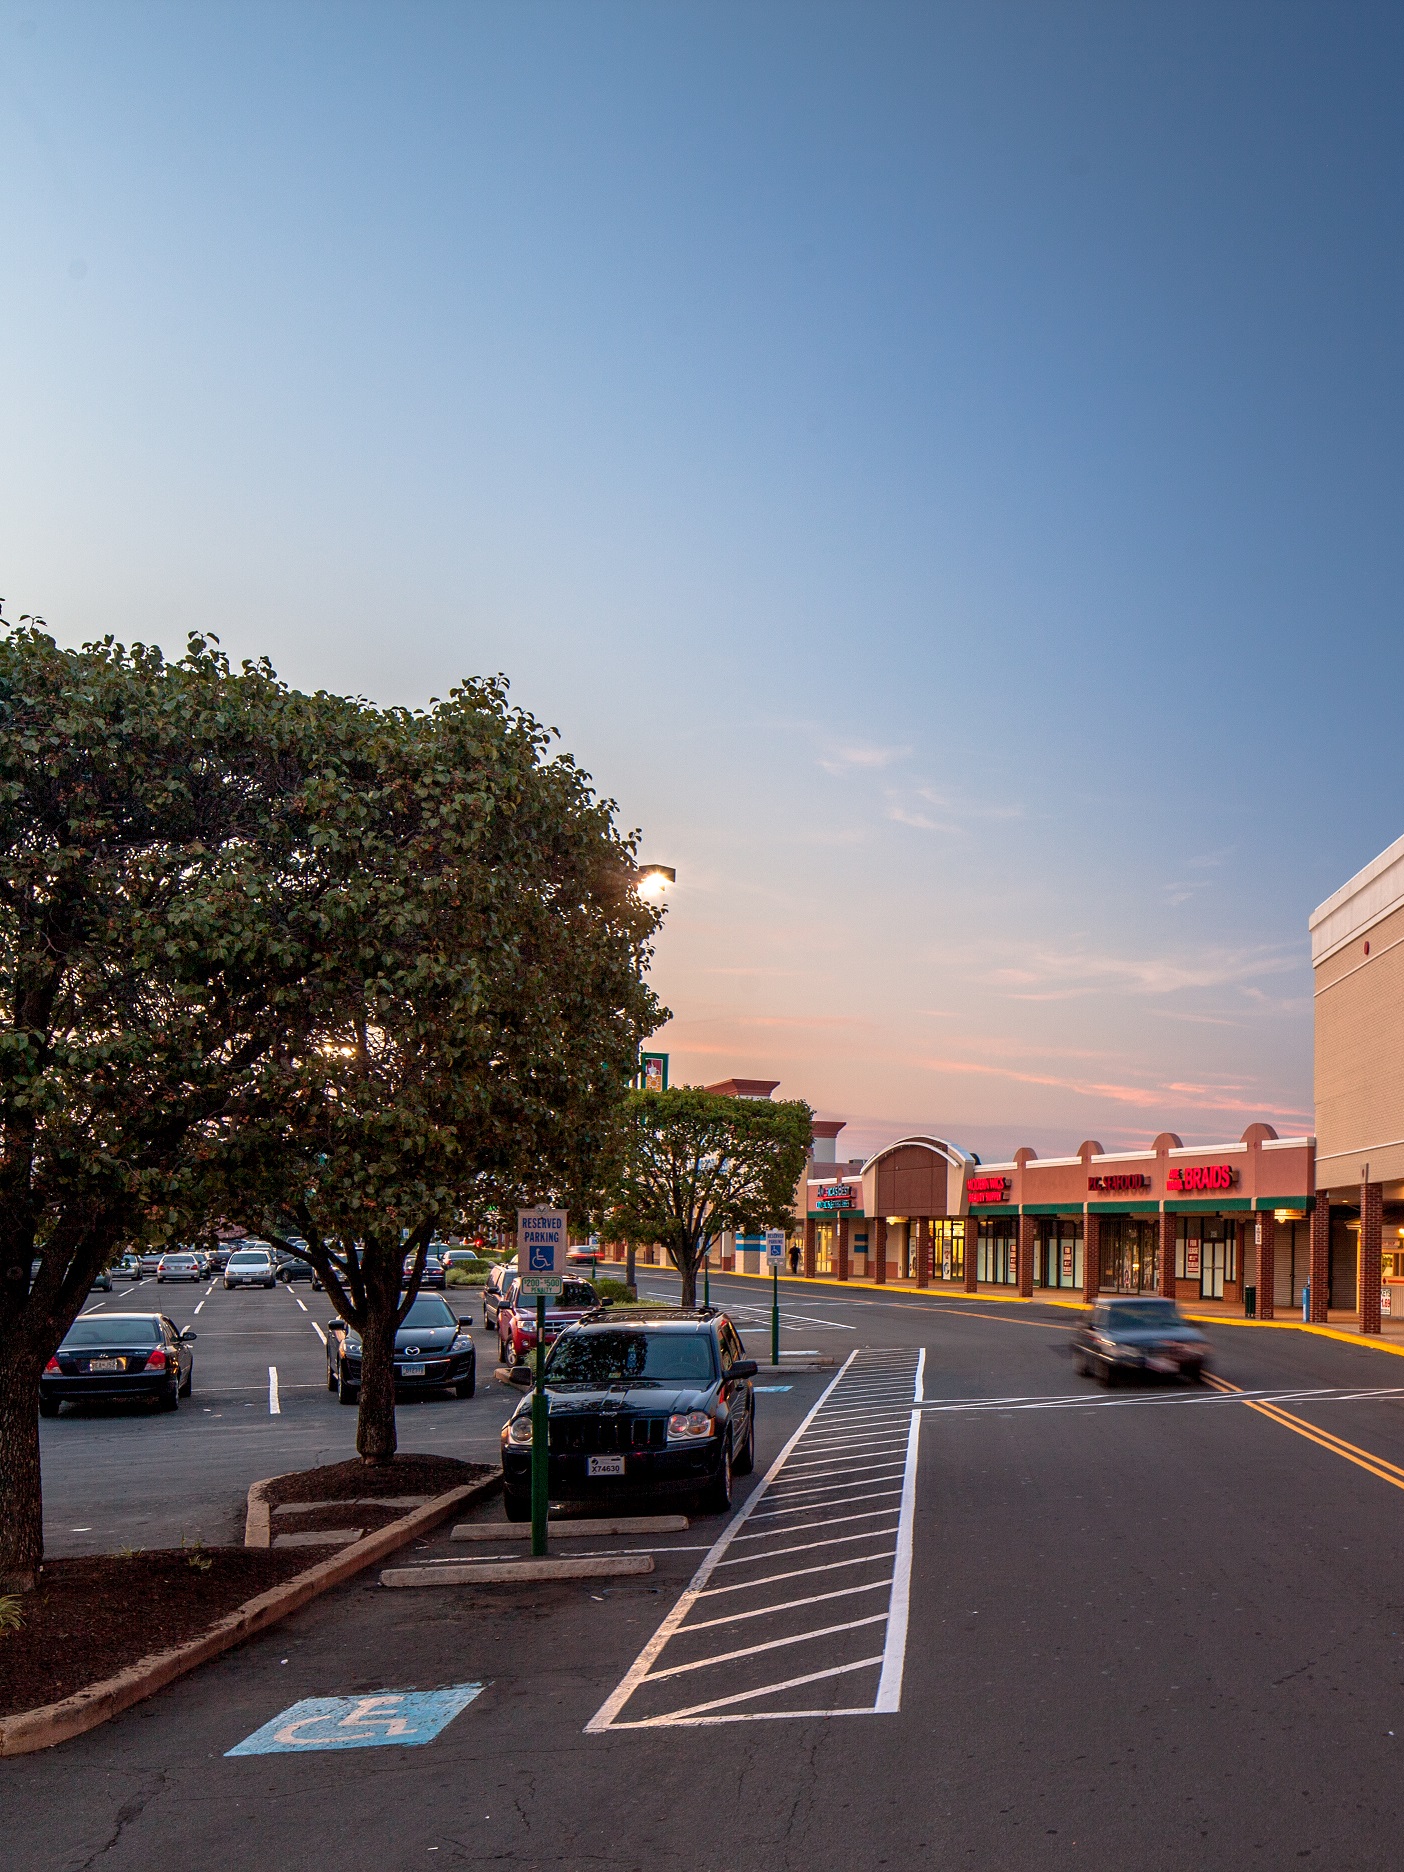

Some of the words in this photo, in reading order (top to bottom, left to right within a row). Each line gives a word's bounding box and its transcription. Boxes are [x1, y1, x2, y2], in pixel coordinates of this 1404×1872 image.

[1103, 1174, 1144, 1190] SEAFOOD
[1184, 1165, 1231, 1191] BRAIDS
[522, 1218, 562, 1229] RESERVED
[524, 1232, 559, 1243] PARKING
